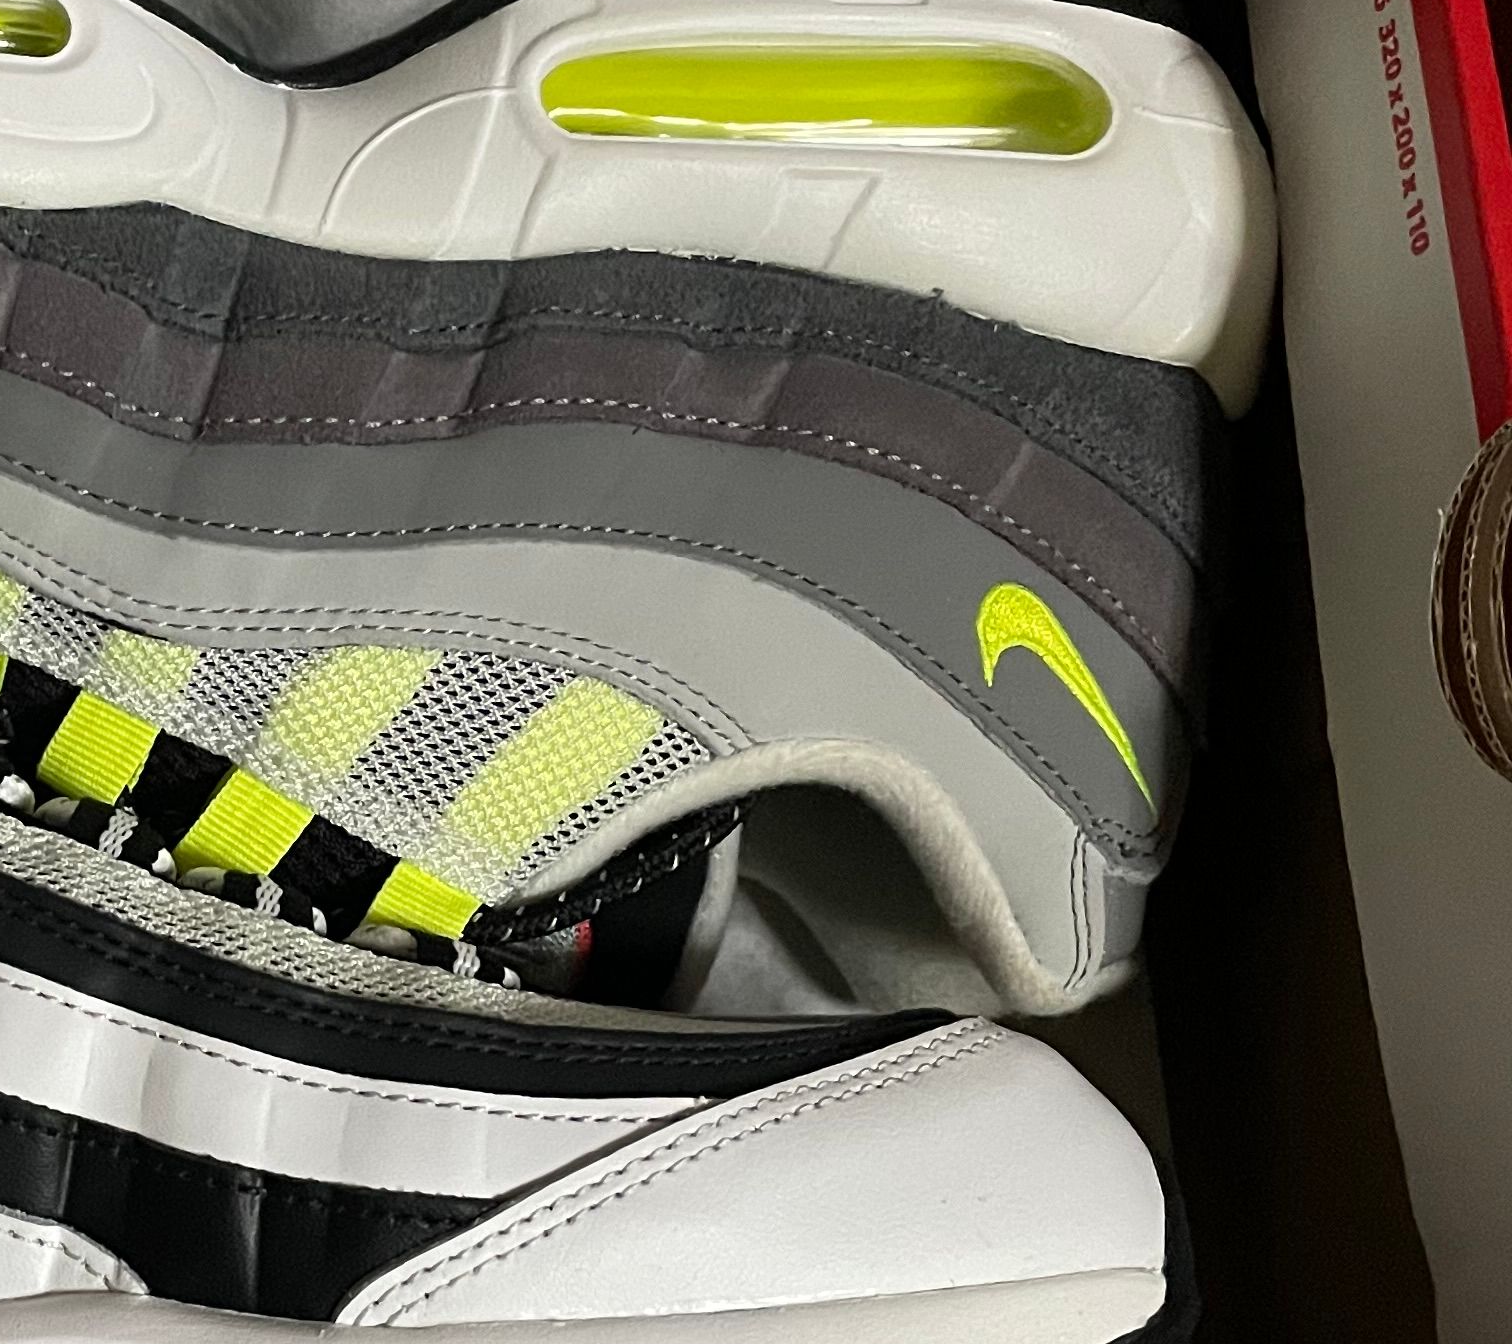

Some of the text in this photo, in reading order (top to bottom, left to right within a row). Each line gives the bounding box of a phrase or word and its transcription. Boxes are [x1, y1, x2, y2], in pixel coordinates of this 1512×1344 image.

[1377, 17, 1402, 82] 320
[1391, 106, 1417, 171] 200
[1405, 197, 1431, 257] 110
